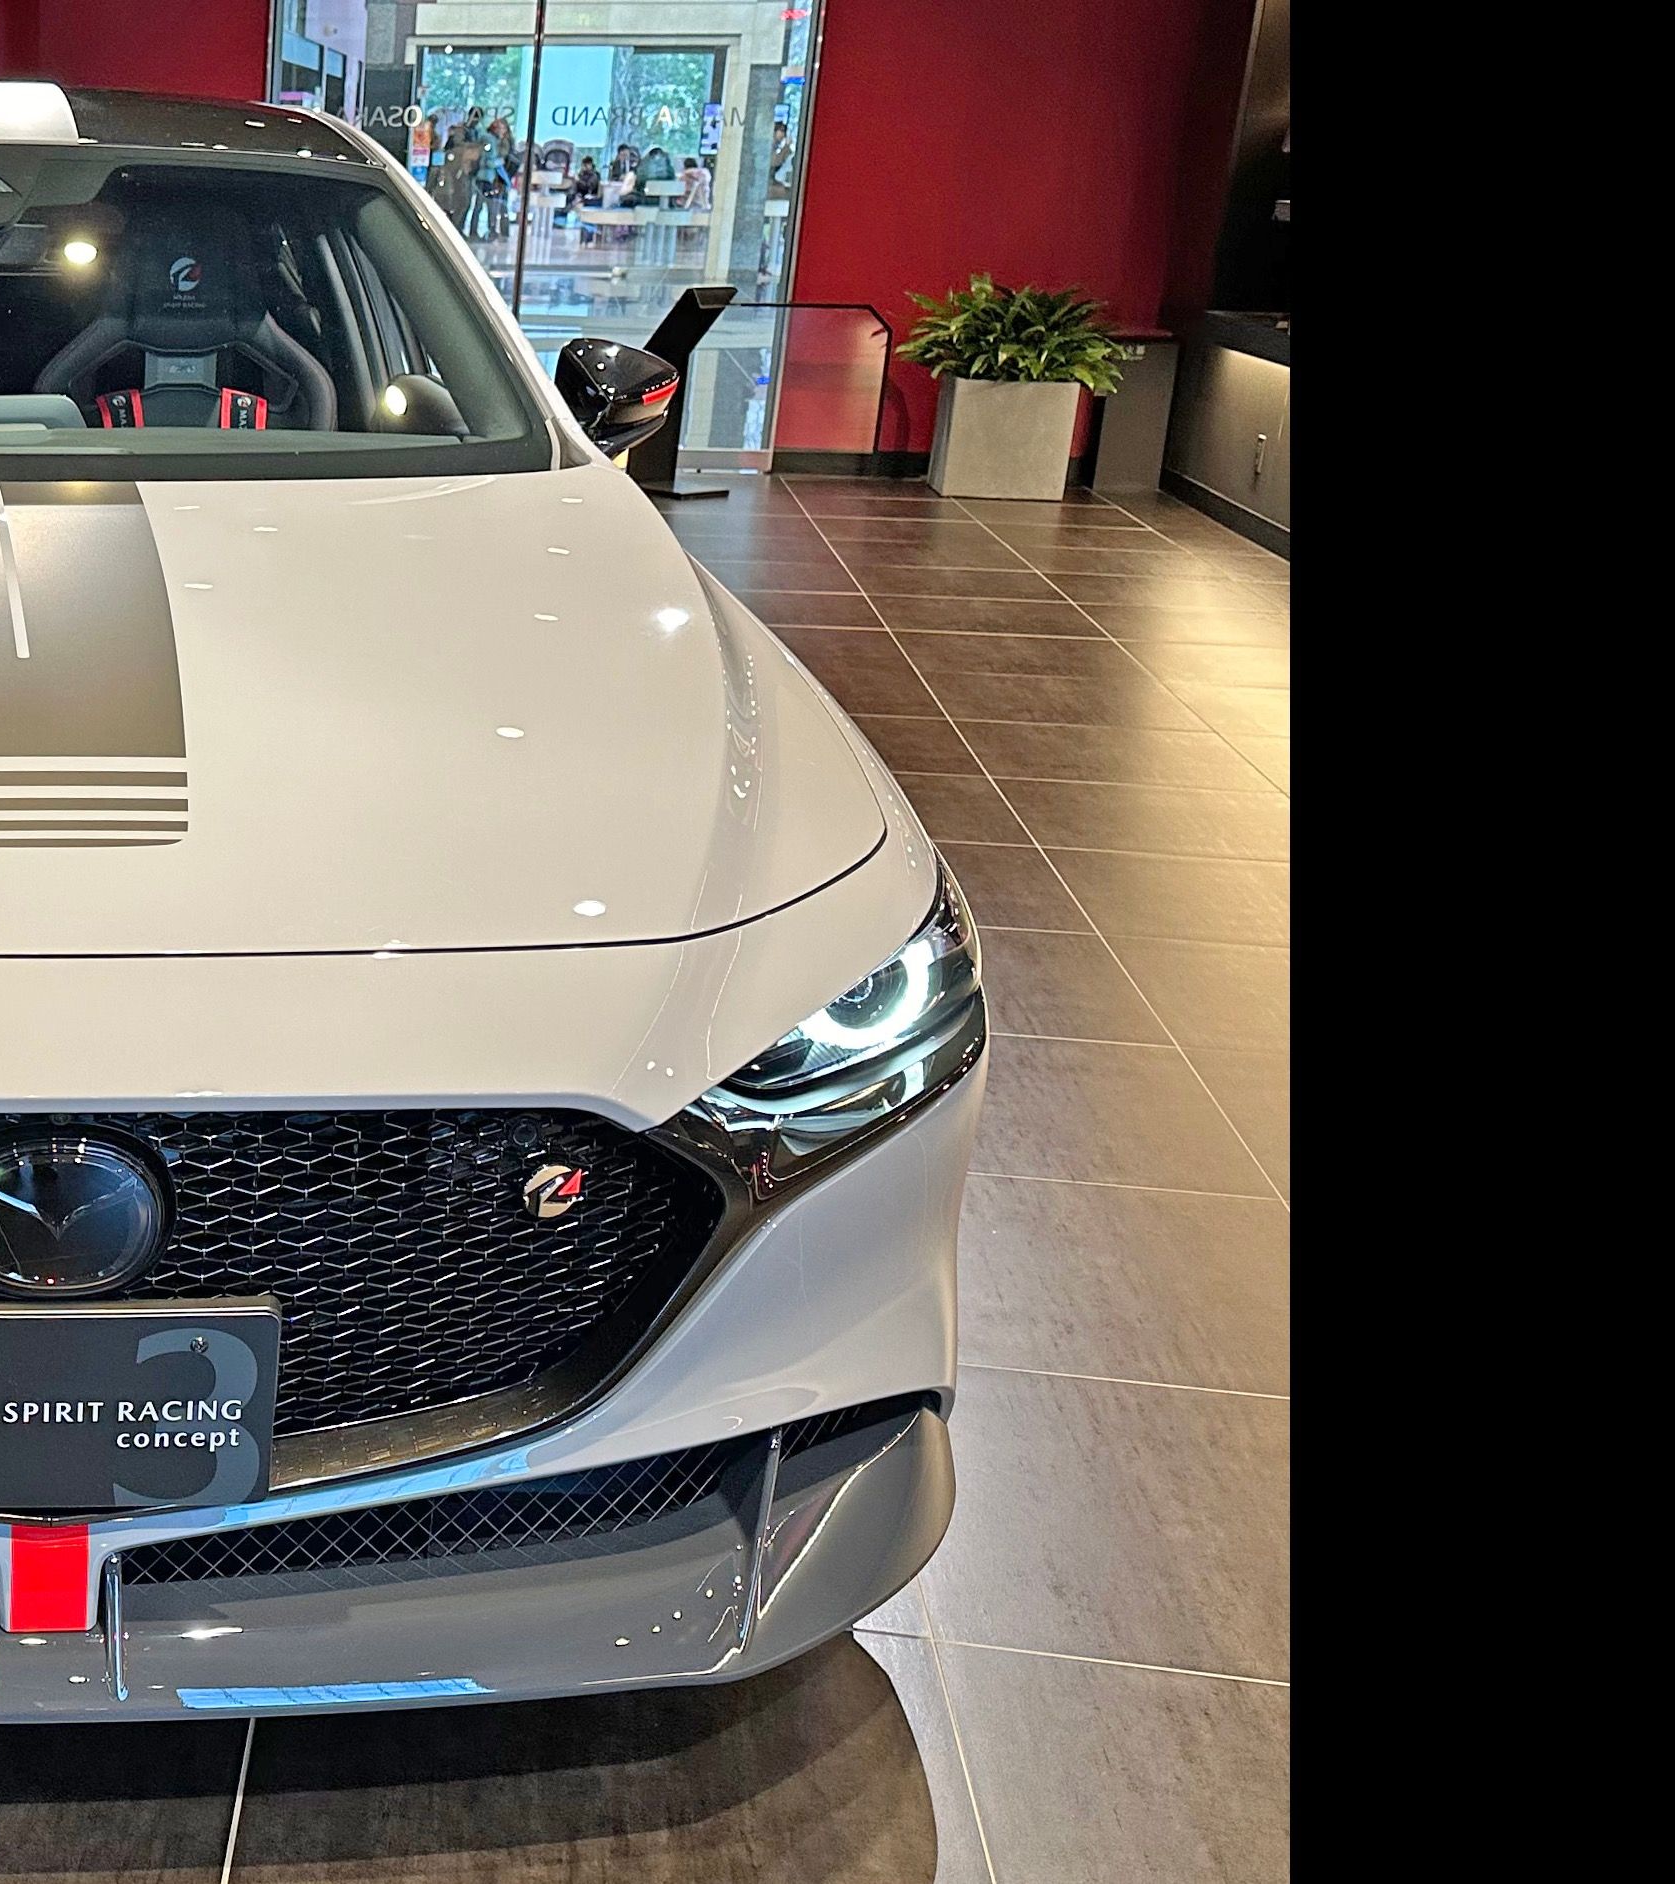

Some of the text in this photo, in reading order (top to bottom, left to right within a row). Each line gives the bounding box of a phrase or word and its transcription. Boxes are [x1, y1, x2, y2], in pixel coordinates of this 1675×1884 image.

[2, 1401, 104, 1424] SPIRIT
[117, 1399, 244, 1423] RACING
[116, 1428, 241, 1453] concept
